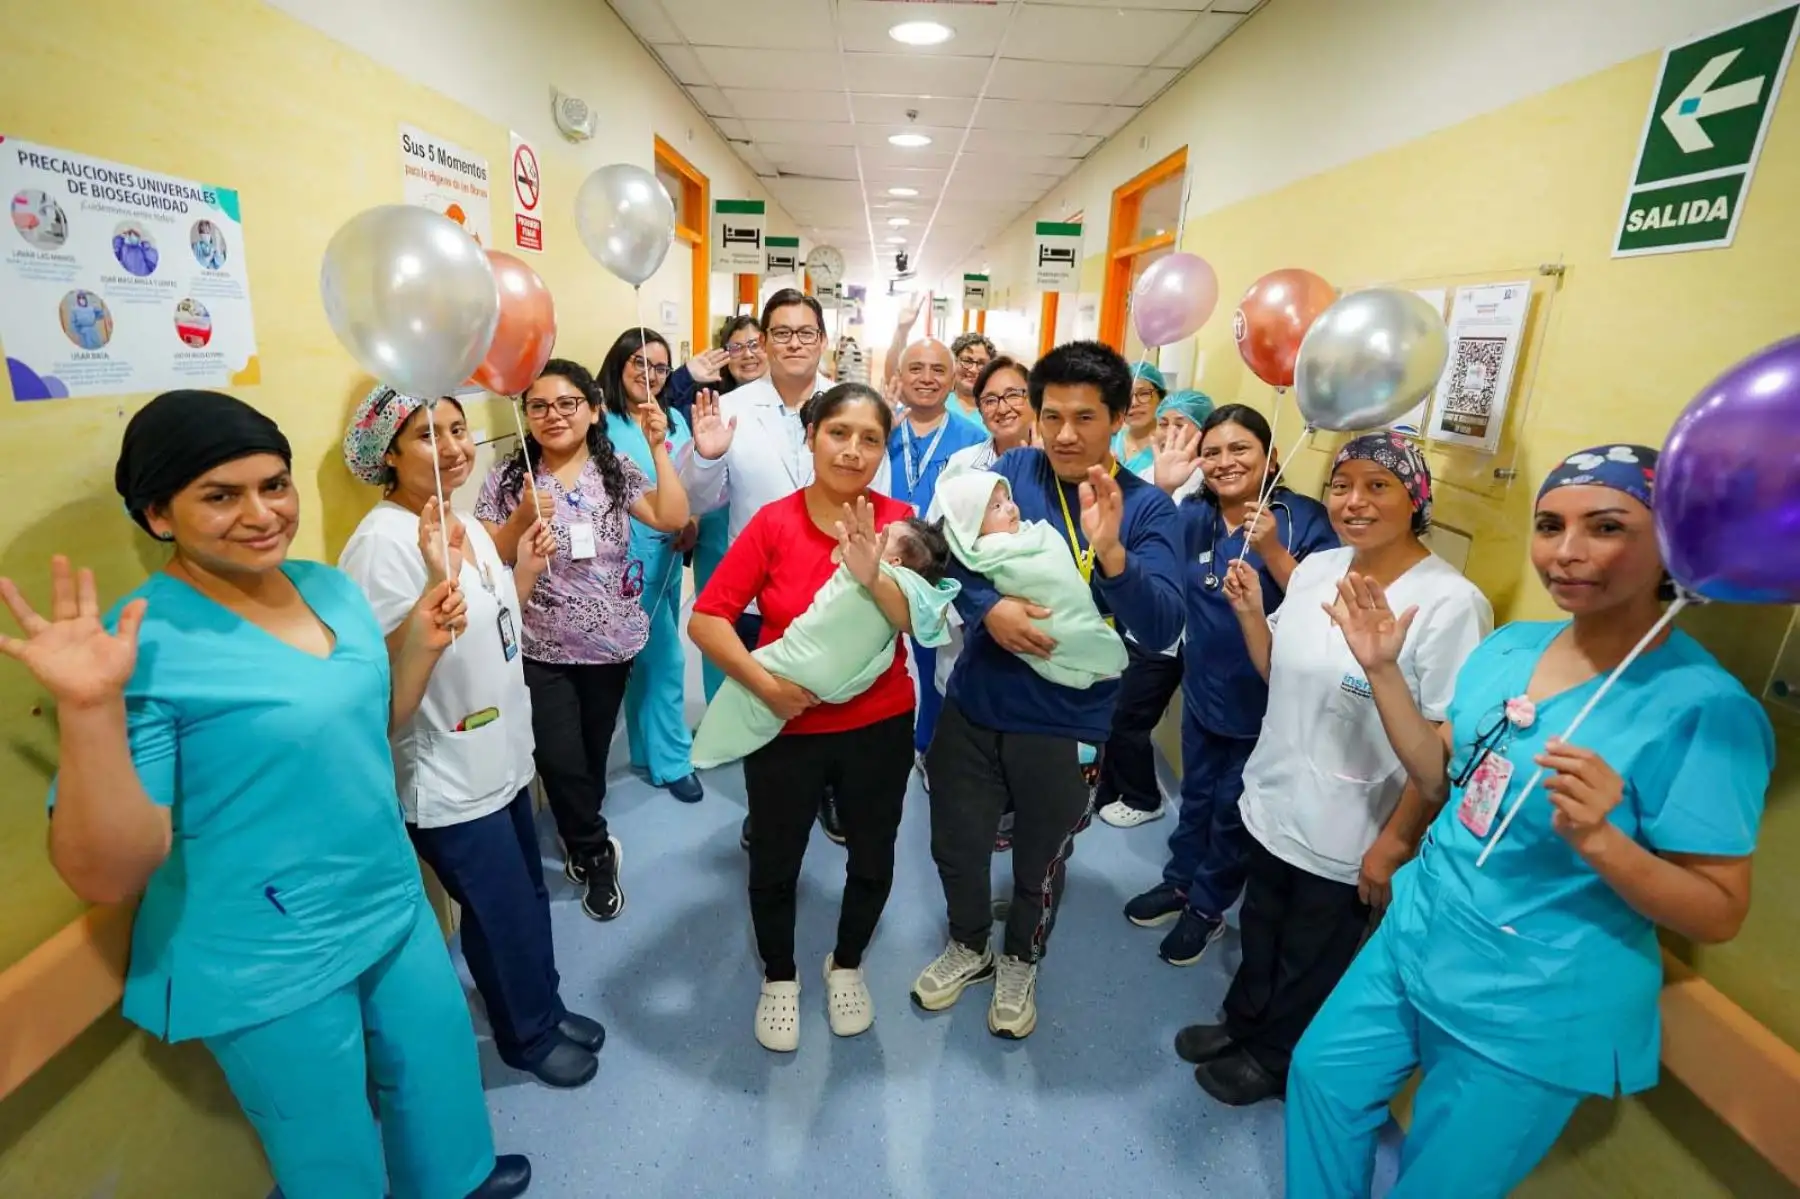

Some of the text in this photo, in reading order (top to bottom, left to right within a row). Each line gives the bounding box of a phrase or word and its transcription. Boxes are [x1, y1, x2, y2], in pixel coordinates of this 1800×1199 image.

[17, 149, 216, 205] PRECAUCIONES UNIVERSALES
[402, 134, 487, 180] Sus 5 Momentos
[67, 178, 189, 214] DE BIOSEGURIDAD
[1626, 196, 1728, 232] SALIDA
